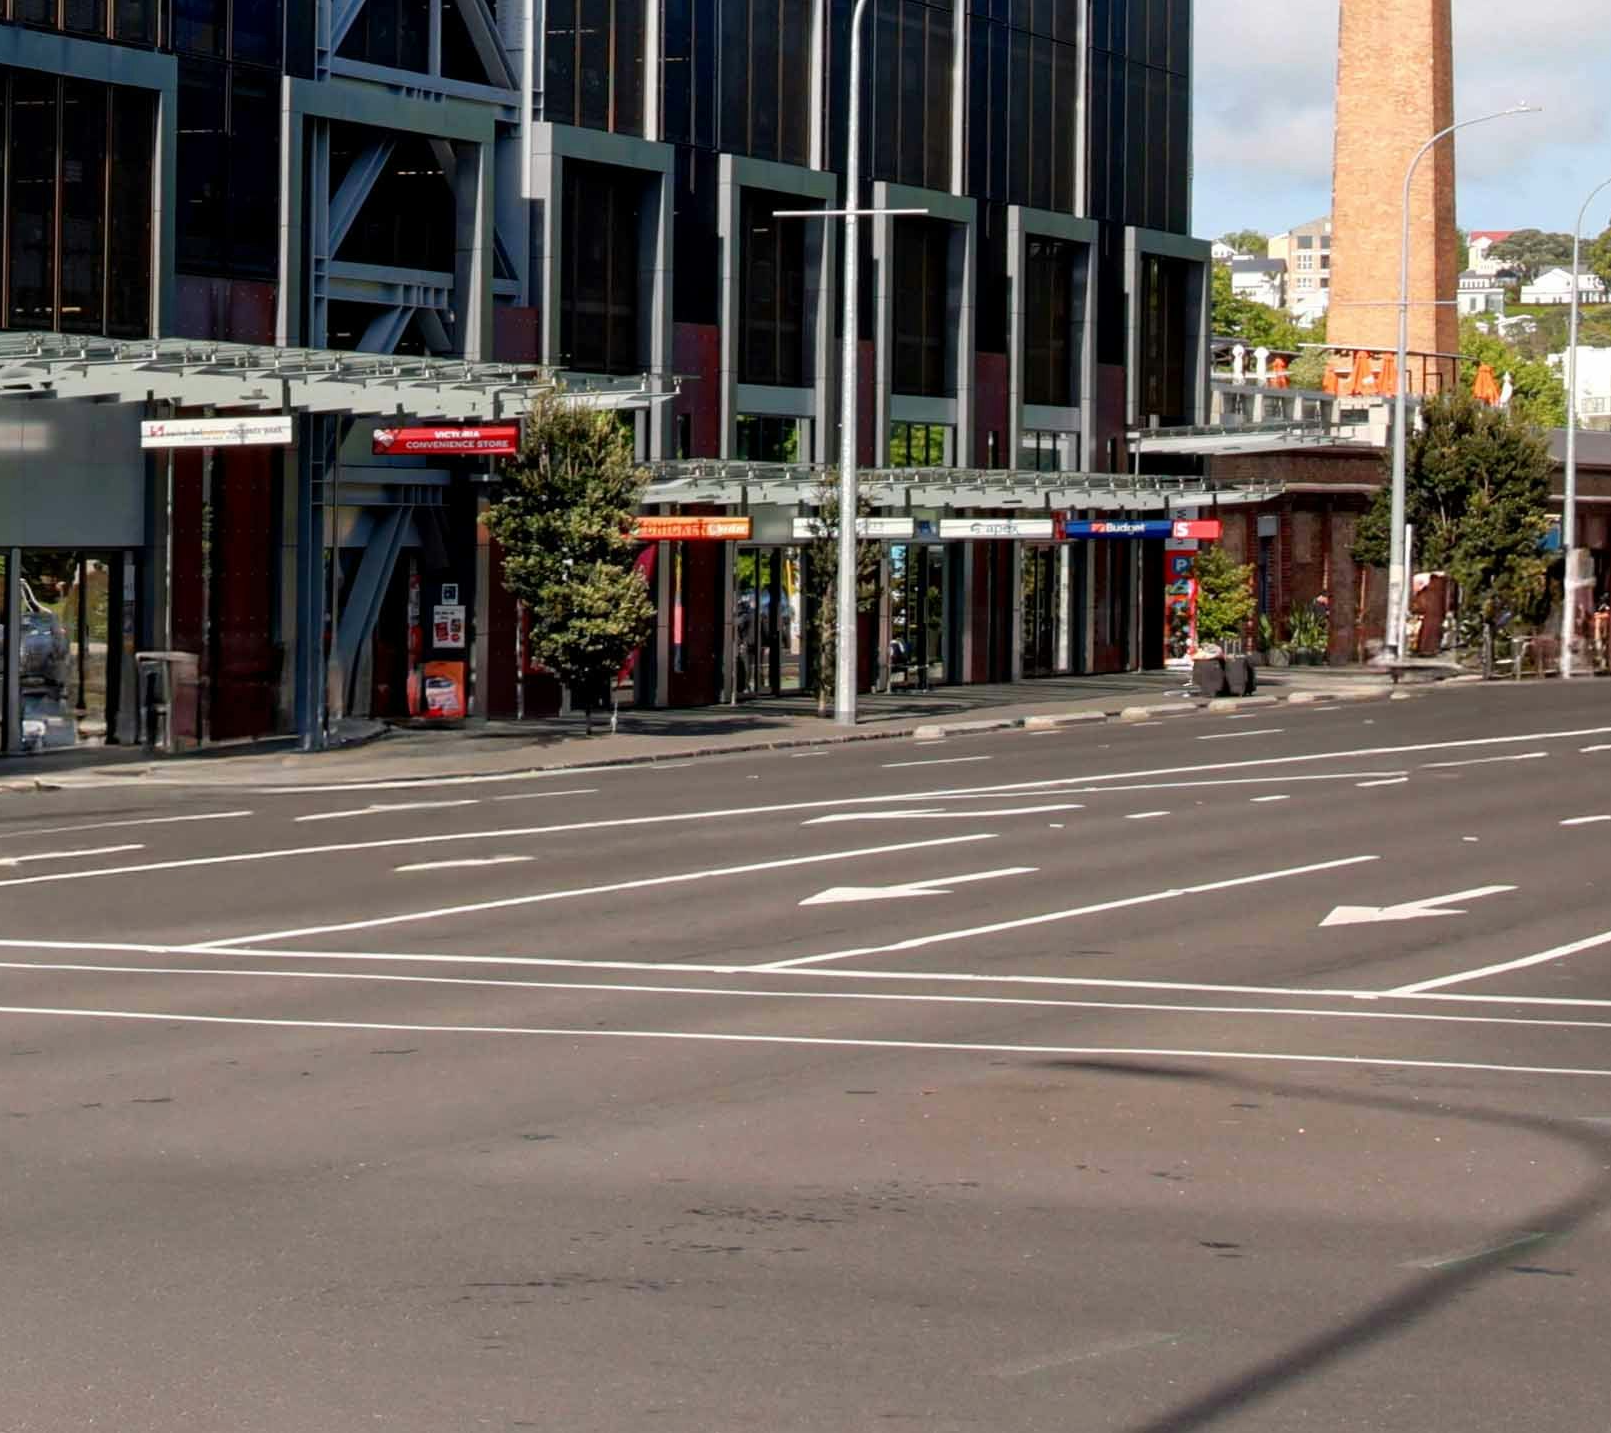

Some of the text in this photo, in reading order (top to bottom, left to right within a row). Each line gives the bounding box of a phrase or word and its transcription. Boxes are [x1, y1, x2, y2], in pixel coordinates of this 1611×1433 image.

[434, 430, 480, 439] VICTORIA
[405, 439, 510, 449] CONVENIENCE STORE
[1105, 522, 1146, 535] Budget
